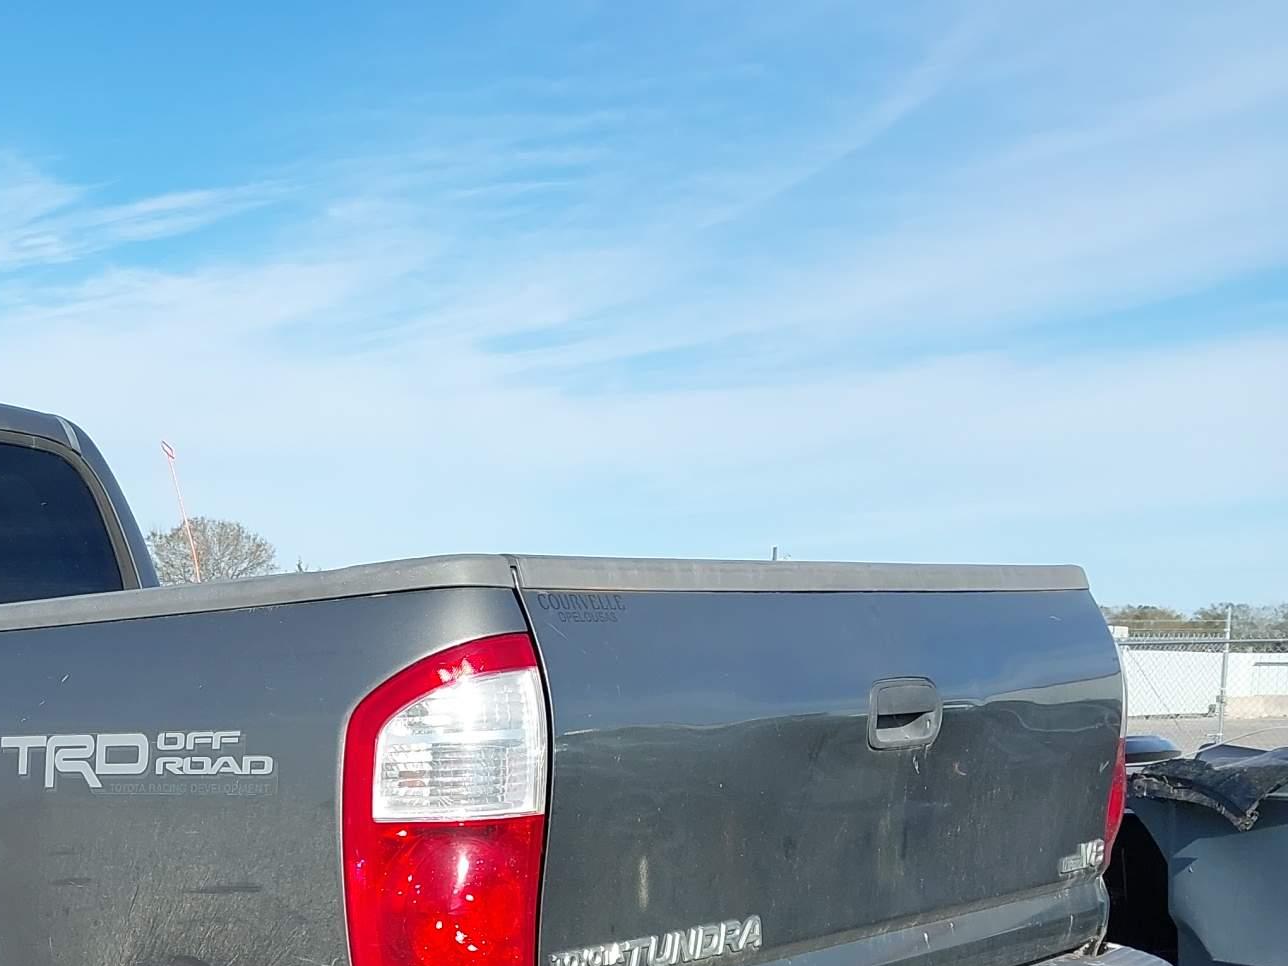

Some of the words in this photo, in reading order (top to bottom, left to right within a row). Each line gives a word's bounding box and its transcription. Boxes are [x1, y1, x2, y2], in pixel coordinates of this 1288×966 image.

[537, 593, 626, 611] COURVELLE
[1, 733, 149, 788] TRD
[157, 730, 242, 750] OFF
[155, 756, 274, 775] ROAD
